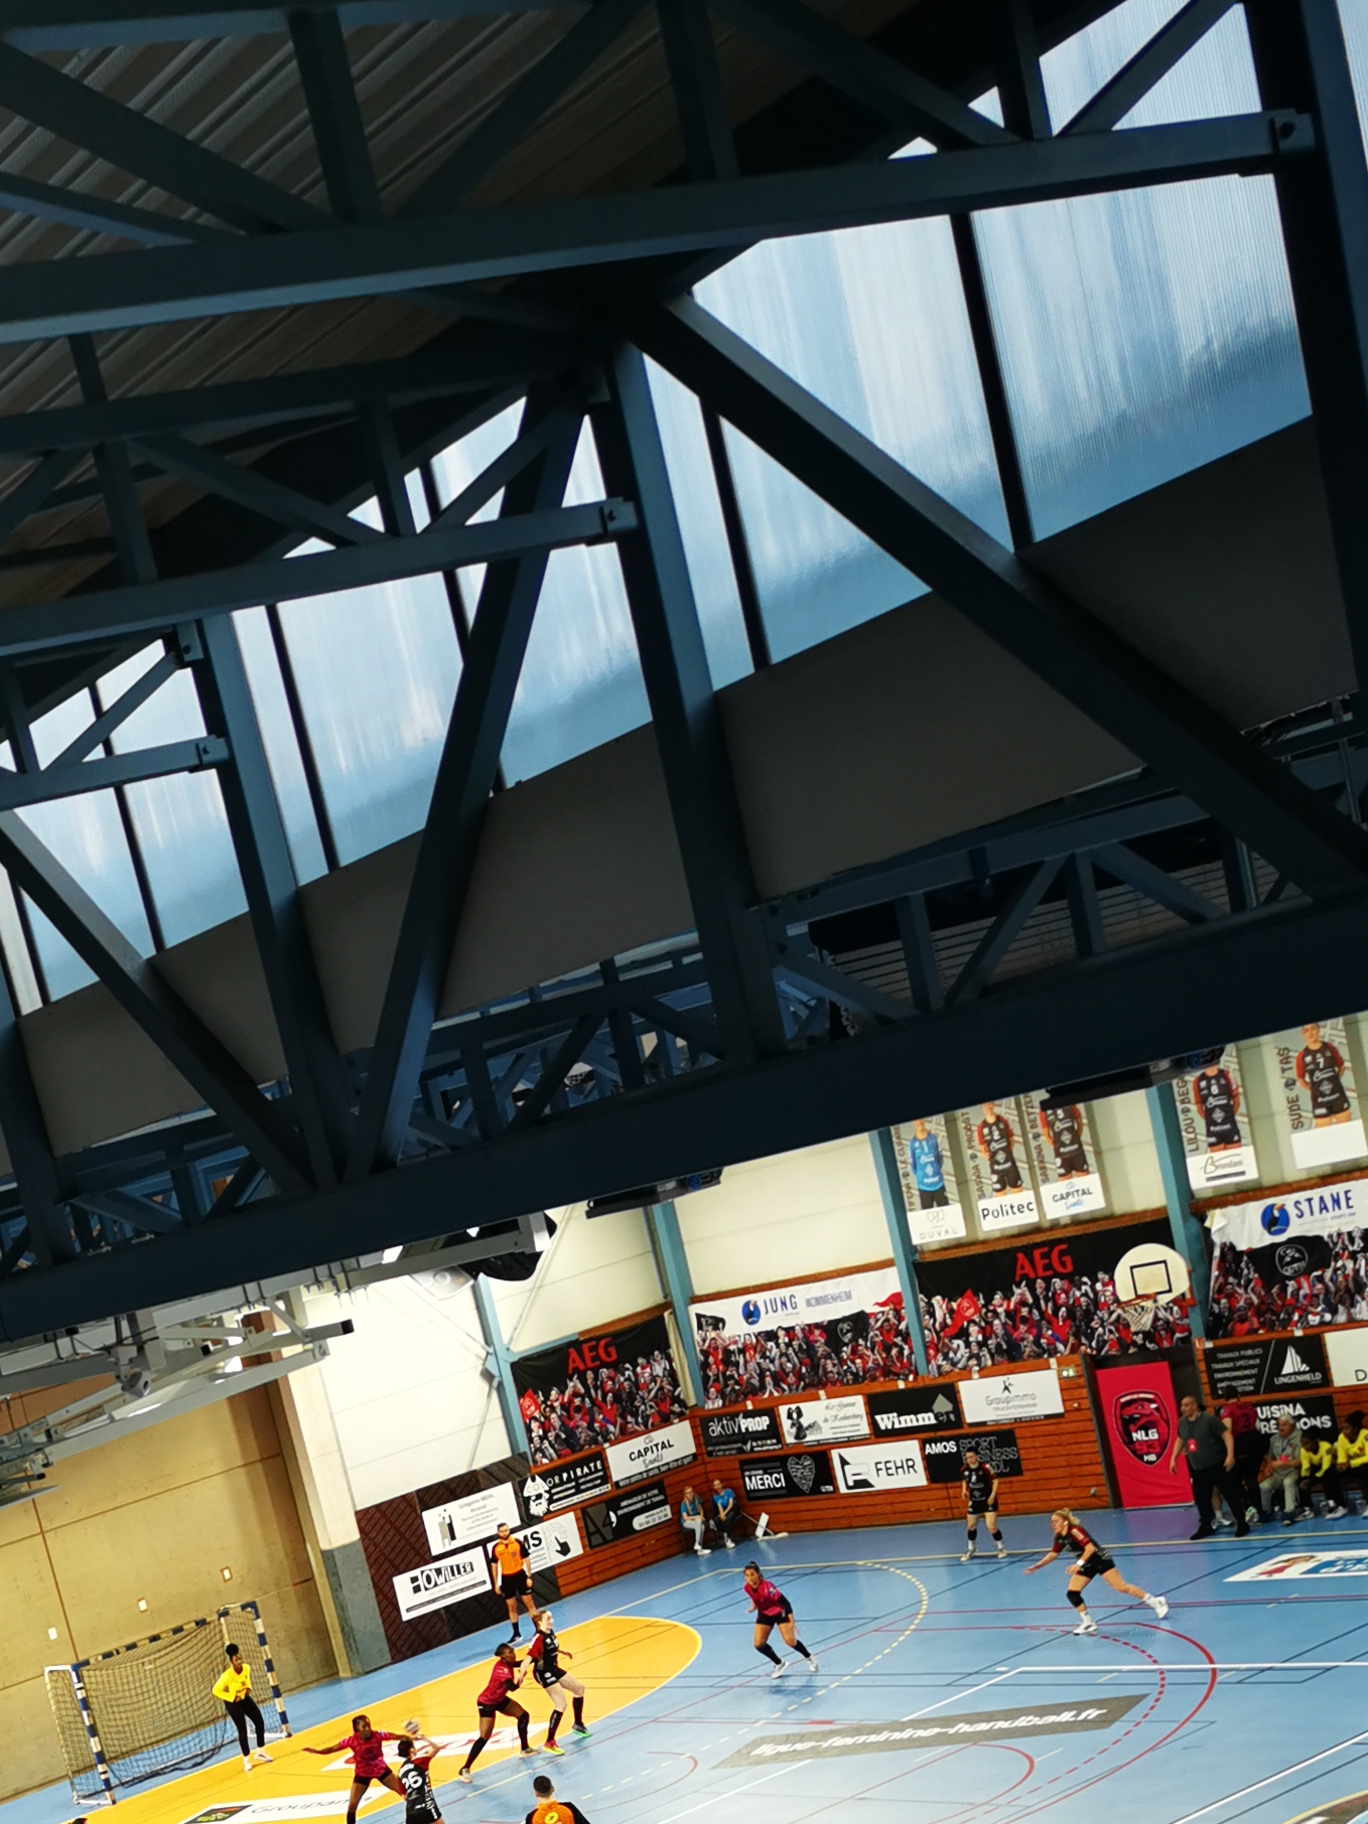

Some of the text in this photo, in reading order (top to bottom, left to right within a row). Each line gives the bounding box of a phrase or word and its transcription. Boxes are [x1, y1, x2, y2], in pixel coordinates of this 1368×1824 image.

[1287, 1094, 1304, 1130] SUDE
[1182, 1118, 1199, 1153] LILOU
[1052, 1186, 1094, 1204] CAPITAL
[1293, 1189, 1354, 1219] STANE
[981, 1201, 1035, 1221] Politec
[919, 1227, 959, 1241] DUVAL
[1015, 1244, 1074, 1282] AEG
[763, 1294, 798, 1315] JUNG
[567, 1337, 618, 1375] AEG
[1274, 1372, 1322, 1385] LINGENHELD
[1131, 1428, 1159, 1442] NLG
[628, 1439, 674, 1462] CAPITAL
[925, 1441, 957, 1455] AMOS
[1133, 1441, 1161, 1455] 93
[562, 1460, 603, 1483] PIRATE
[875, 1458, 918, 1477] FEHR
[745, 1472, 786, 1491] MERCI
